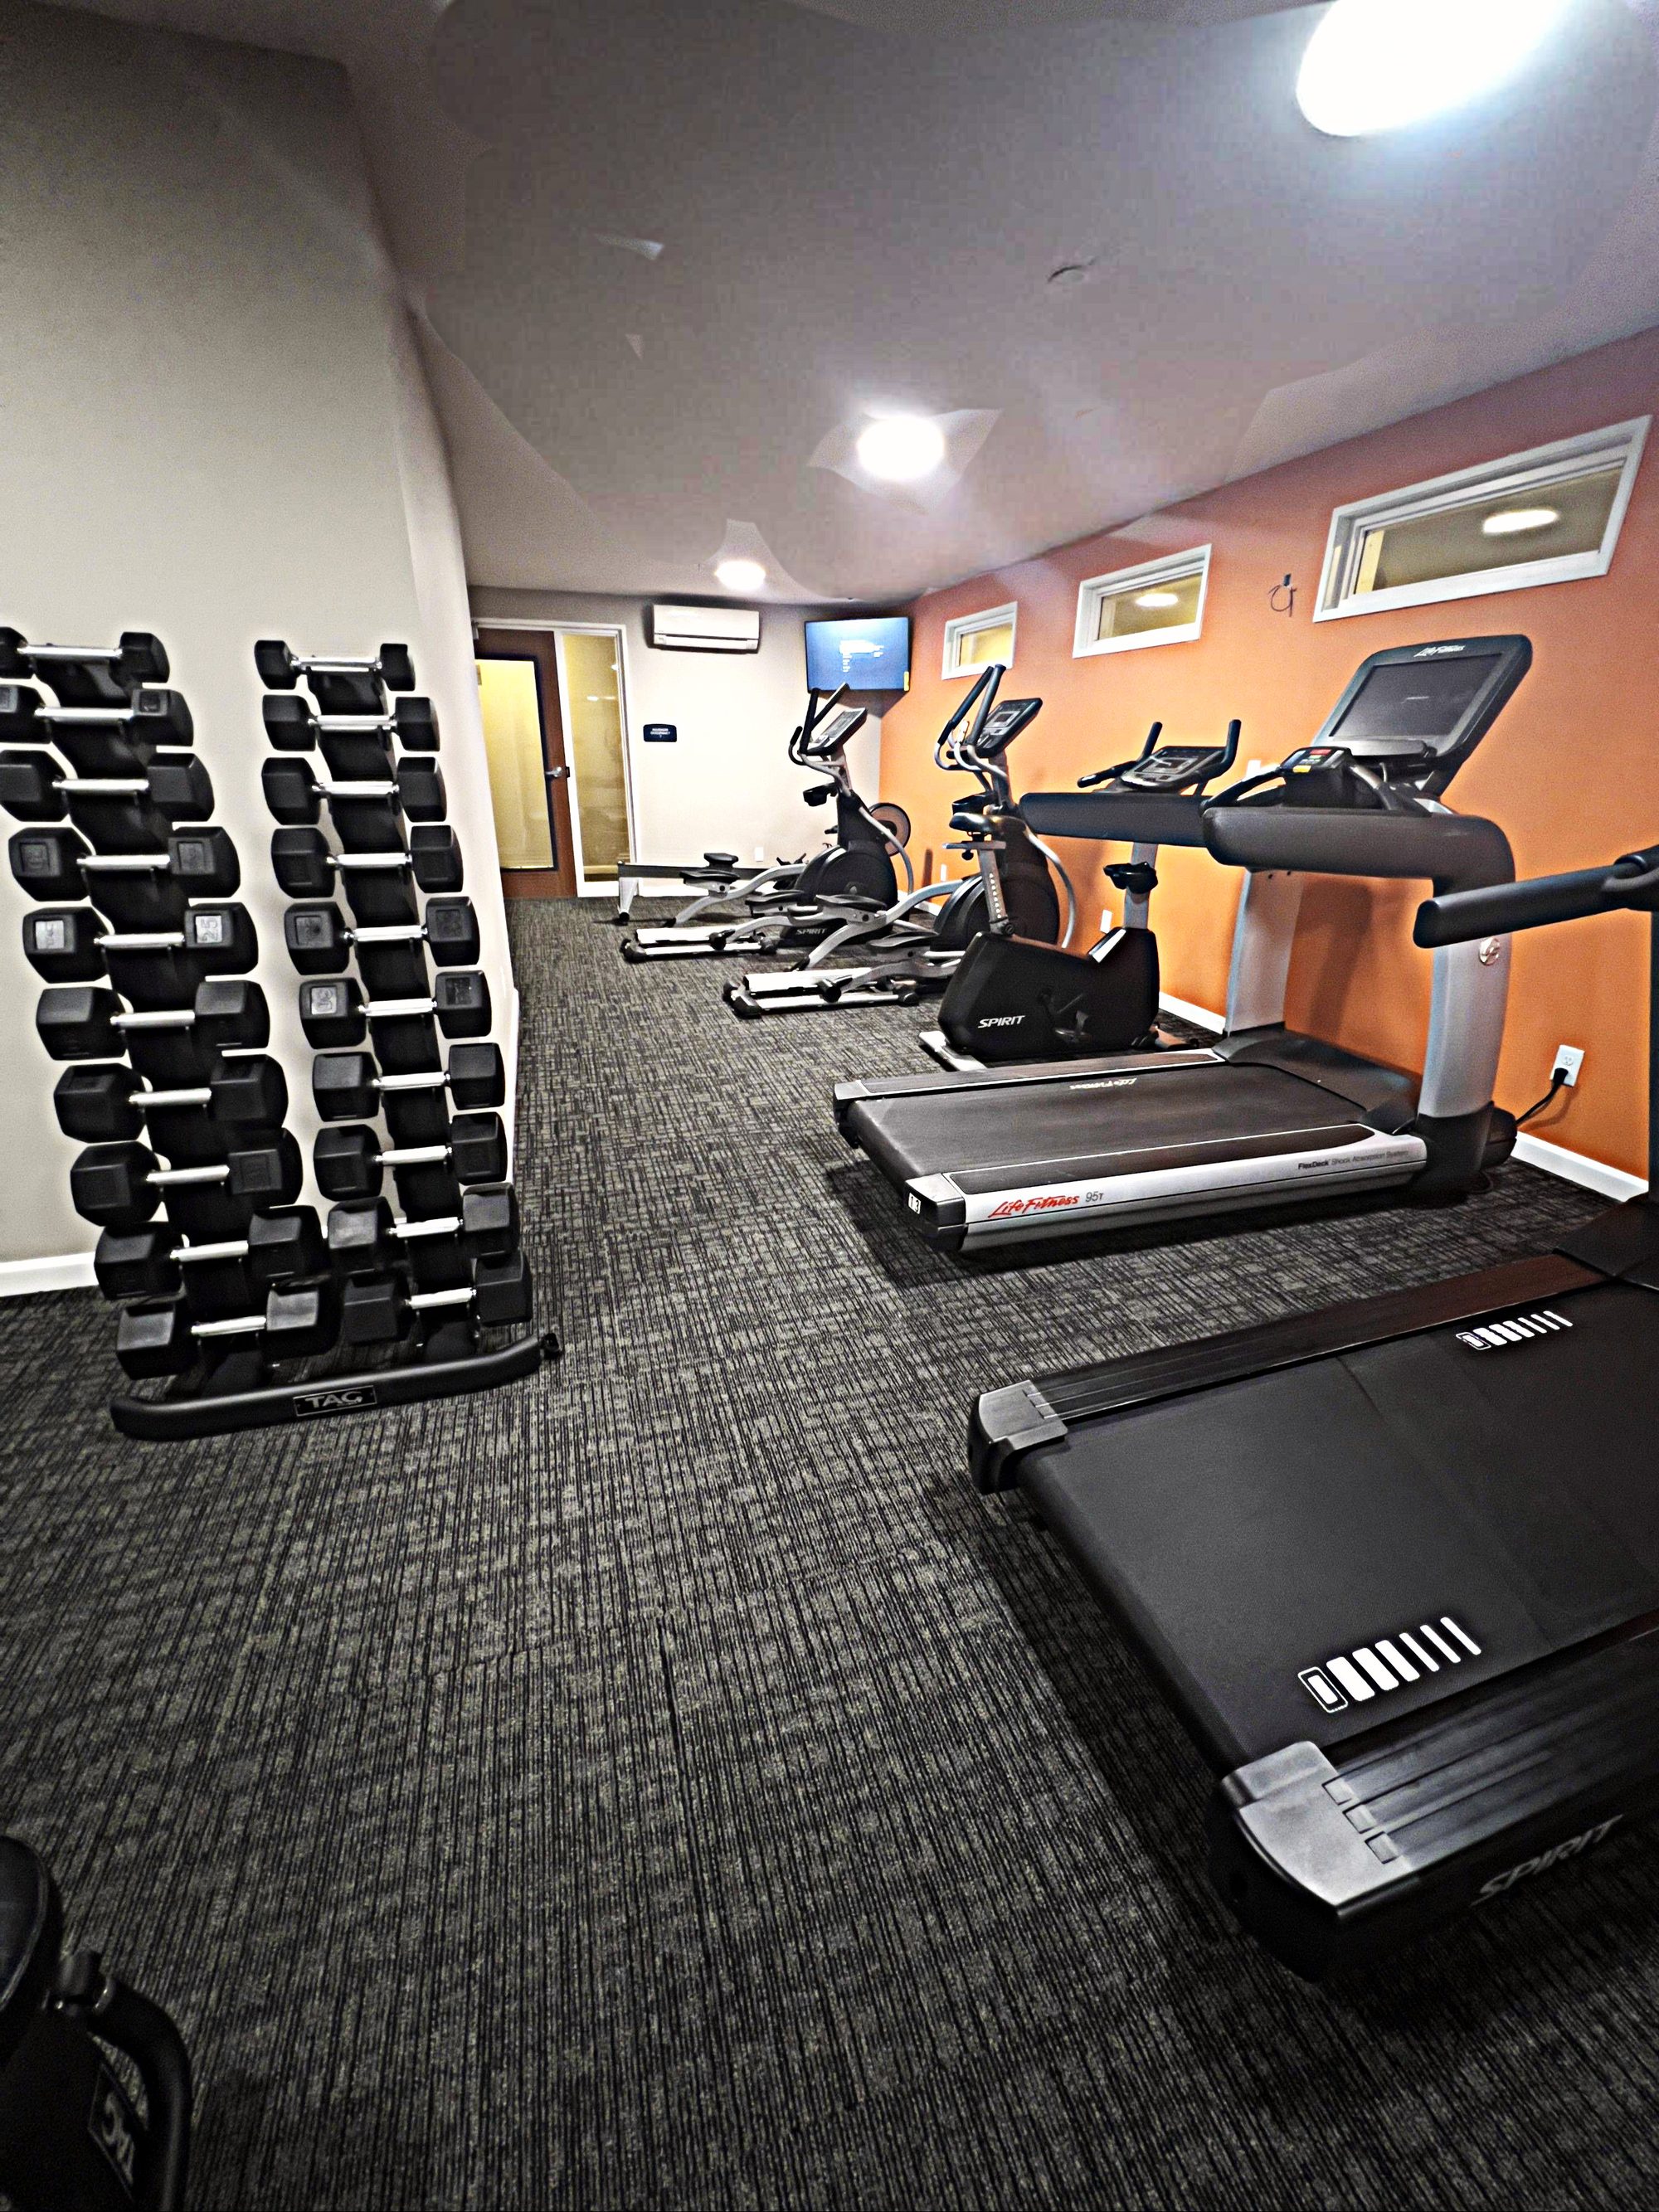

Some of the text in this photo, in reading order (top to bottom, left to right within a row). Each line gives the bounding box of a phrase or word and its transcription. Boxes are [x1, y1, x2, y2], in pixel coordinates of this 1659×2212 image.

[977, 1015, 1026, 1028] SPIRIT
[304, 1391, 362, 1408] TAG
[1471, 1814, 1623, 1907] SPIRIT
